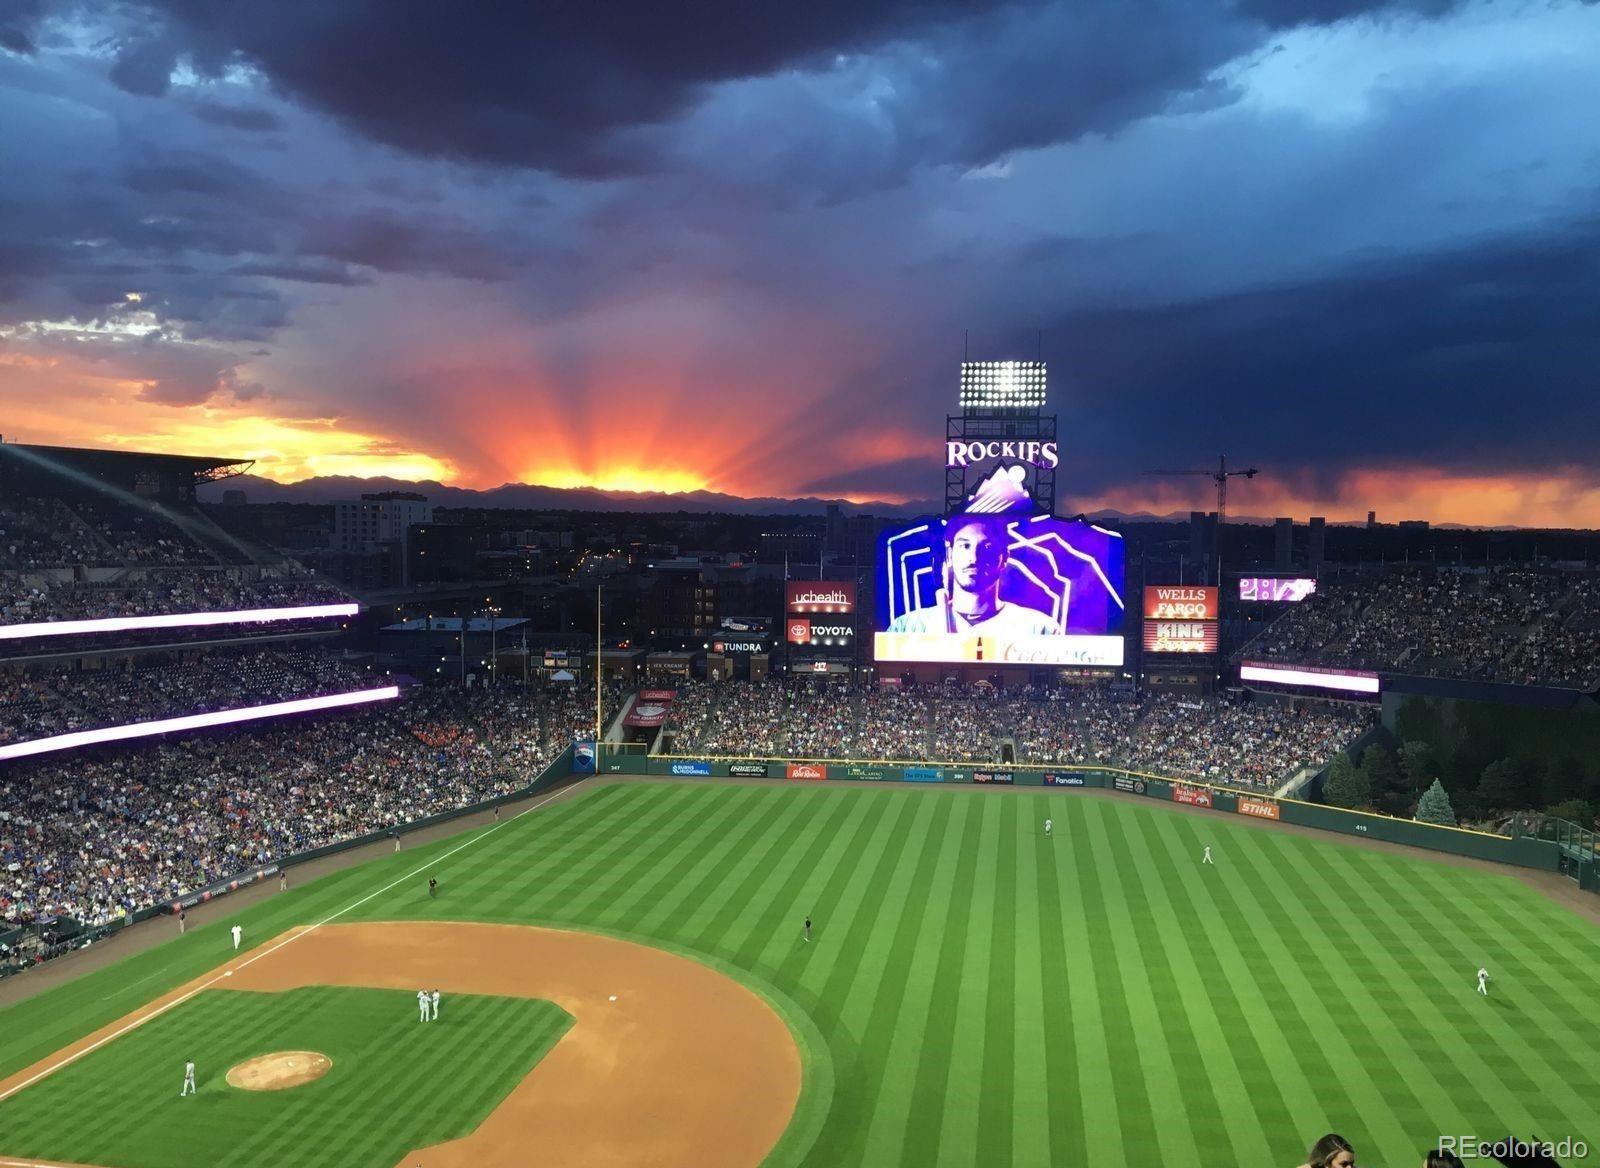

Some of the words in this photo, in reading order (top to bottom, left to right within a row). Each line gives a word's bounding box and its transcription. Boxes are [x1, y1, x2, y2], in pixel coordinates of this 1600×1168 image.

[945, 441, 1059, 469] ROCKIES
[795, 590, 847, 603] uchealth
[1157, 589, 1206, 600] WELLS
[1158, 603, 1206, 615] FARGO
[810, 626, 854, 636] TOYOTA
[1157, 624, 1205, 638] KING
[724, 643, 762, 652] TUNDRA
[1055, 776, 1084, 785] Fanatics
[1241, 803, 1275, 817] STIHL
